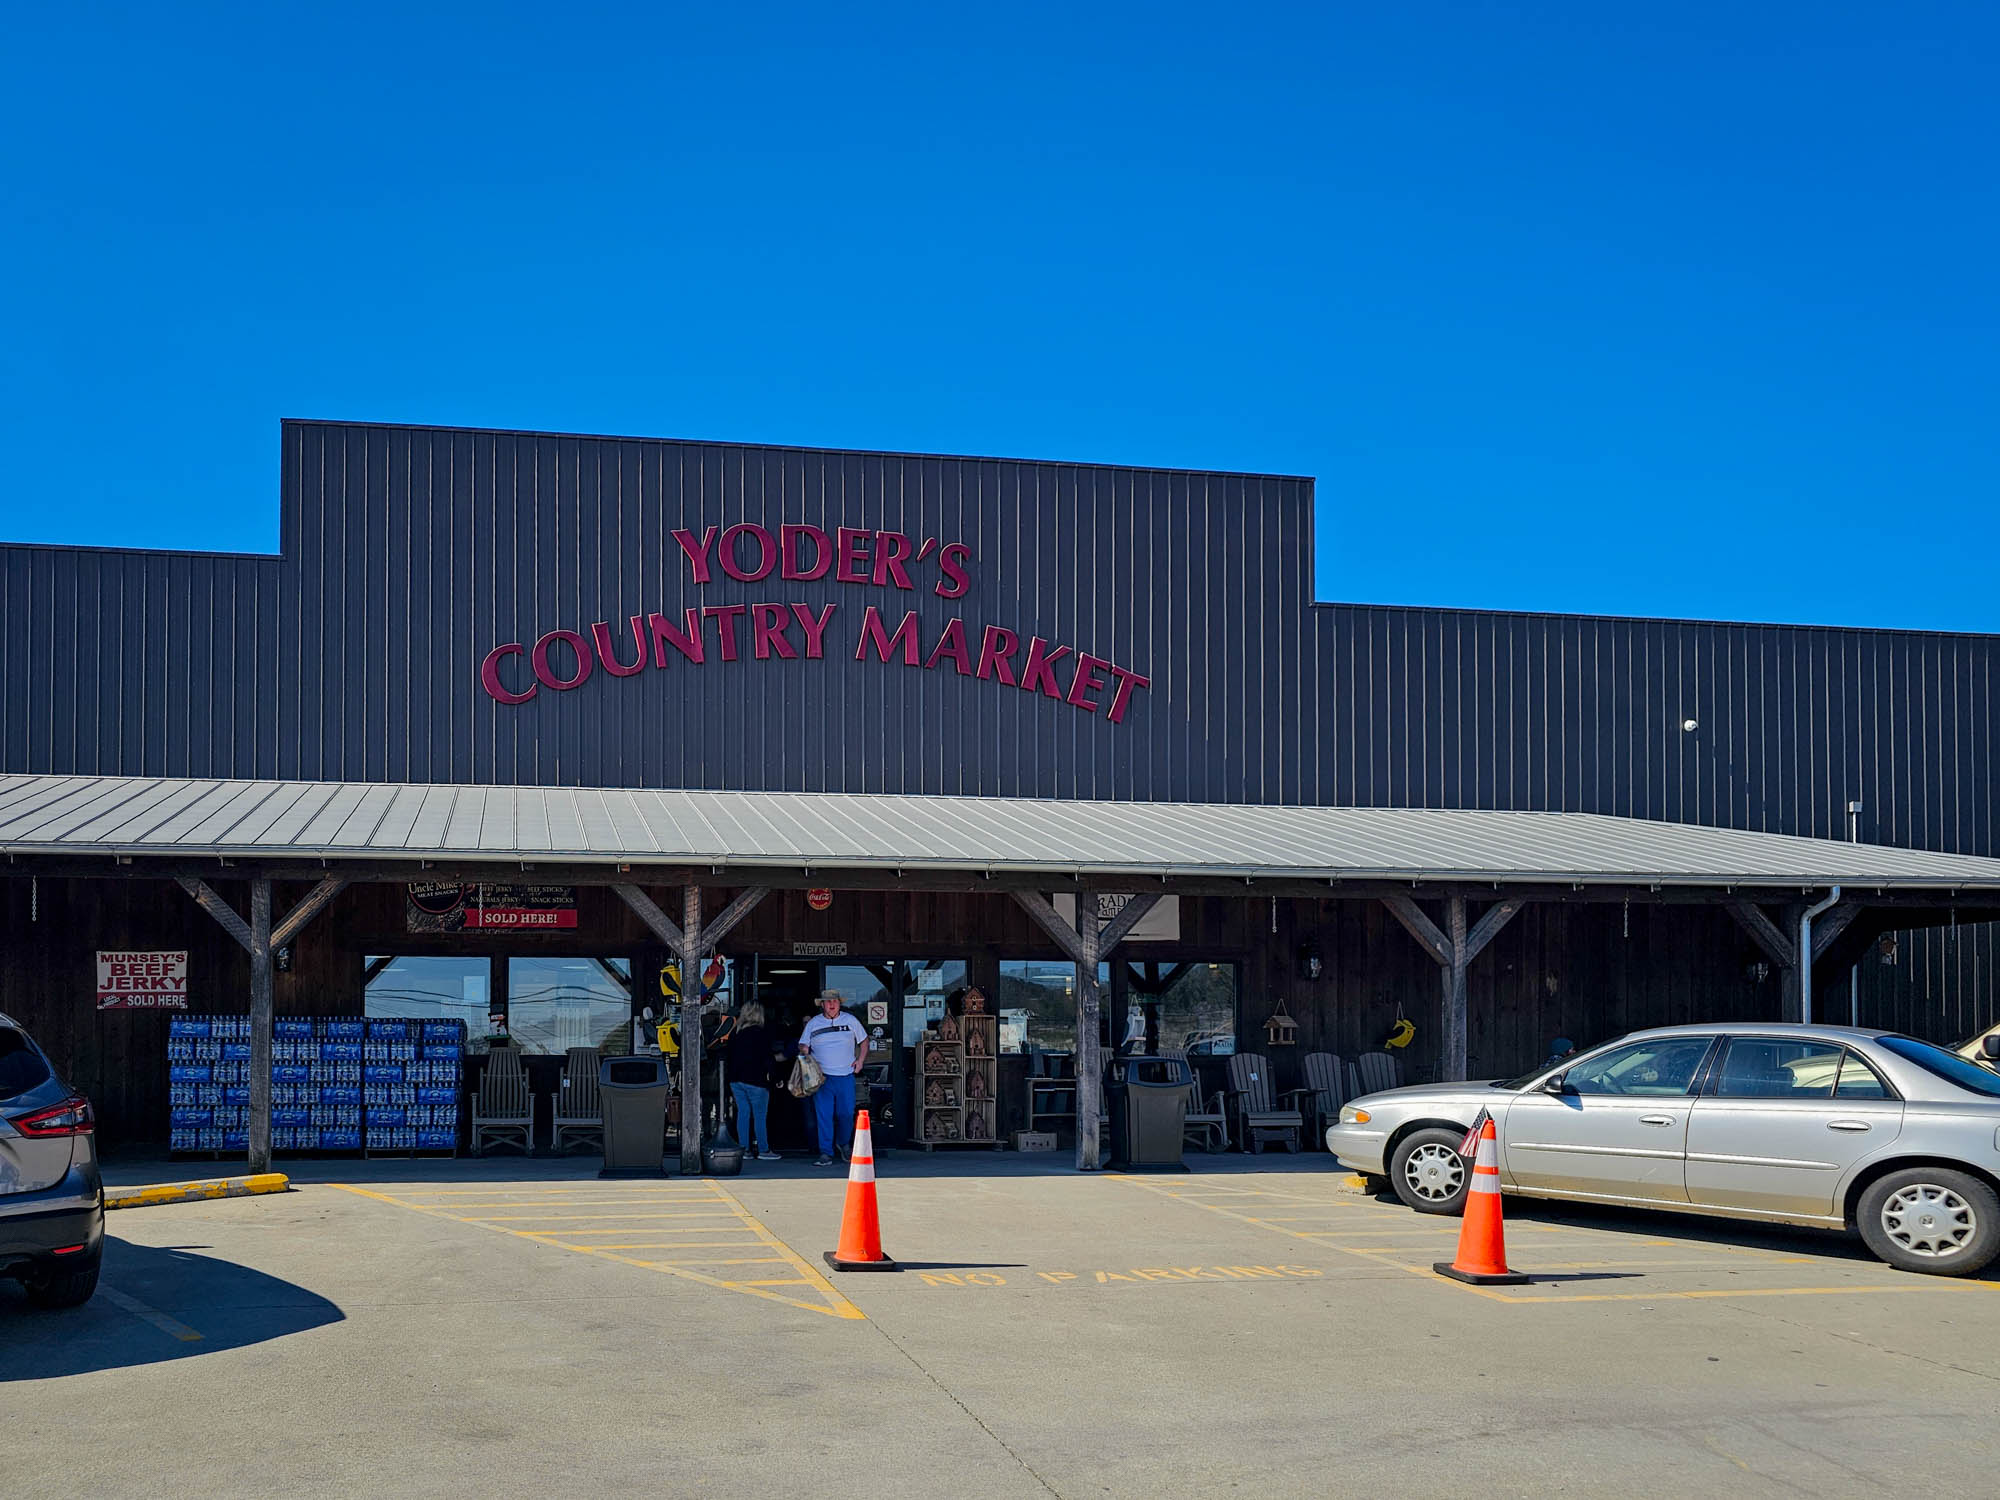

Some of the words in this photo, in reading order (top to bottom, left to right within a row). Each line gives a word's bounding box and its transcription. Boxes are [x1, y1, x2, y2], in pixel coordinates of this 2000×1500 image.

[670, 523, 973, 598] YODER'S
[480, 603, 837, 705] COUNTRY
[855, 606, 1151, 724] MARKET
[485, 912, 518, 923] SOLD
[521, 913, 558, 924] HERE!
[799, 943, 842, 955] WELCOME
[100, 953, 186, 963] MUNSEY'S
[111, 963, 176, 977] BEEF
[99, 976, 186, 990] JERKY
[127, 995, 155, 1006] SOLD
[158, 995, 186, 1006] HERE
[919, 1272, 1007, 1287] NO
[1036, 1264, 1323, 1285] PARKING
